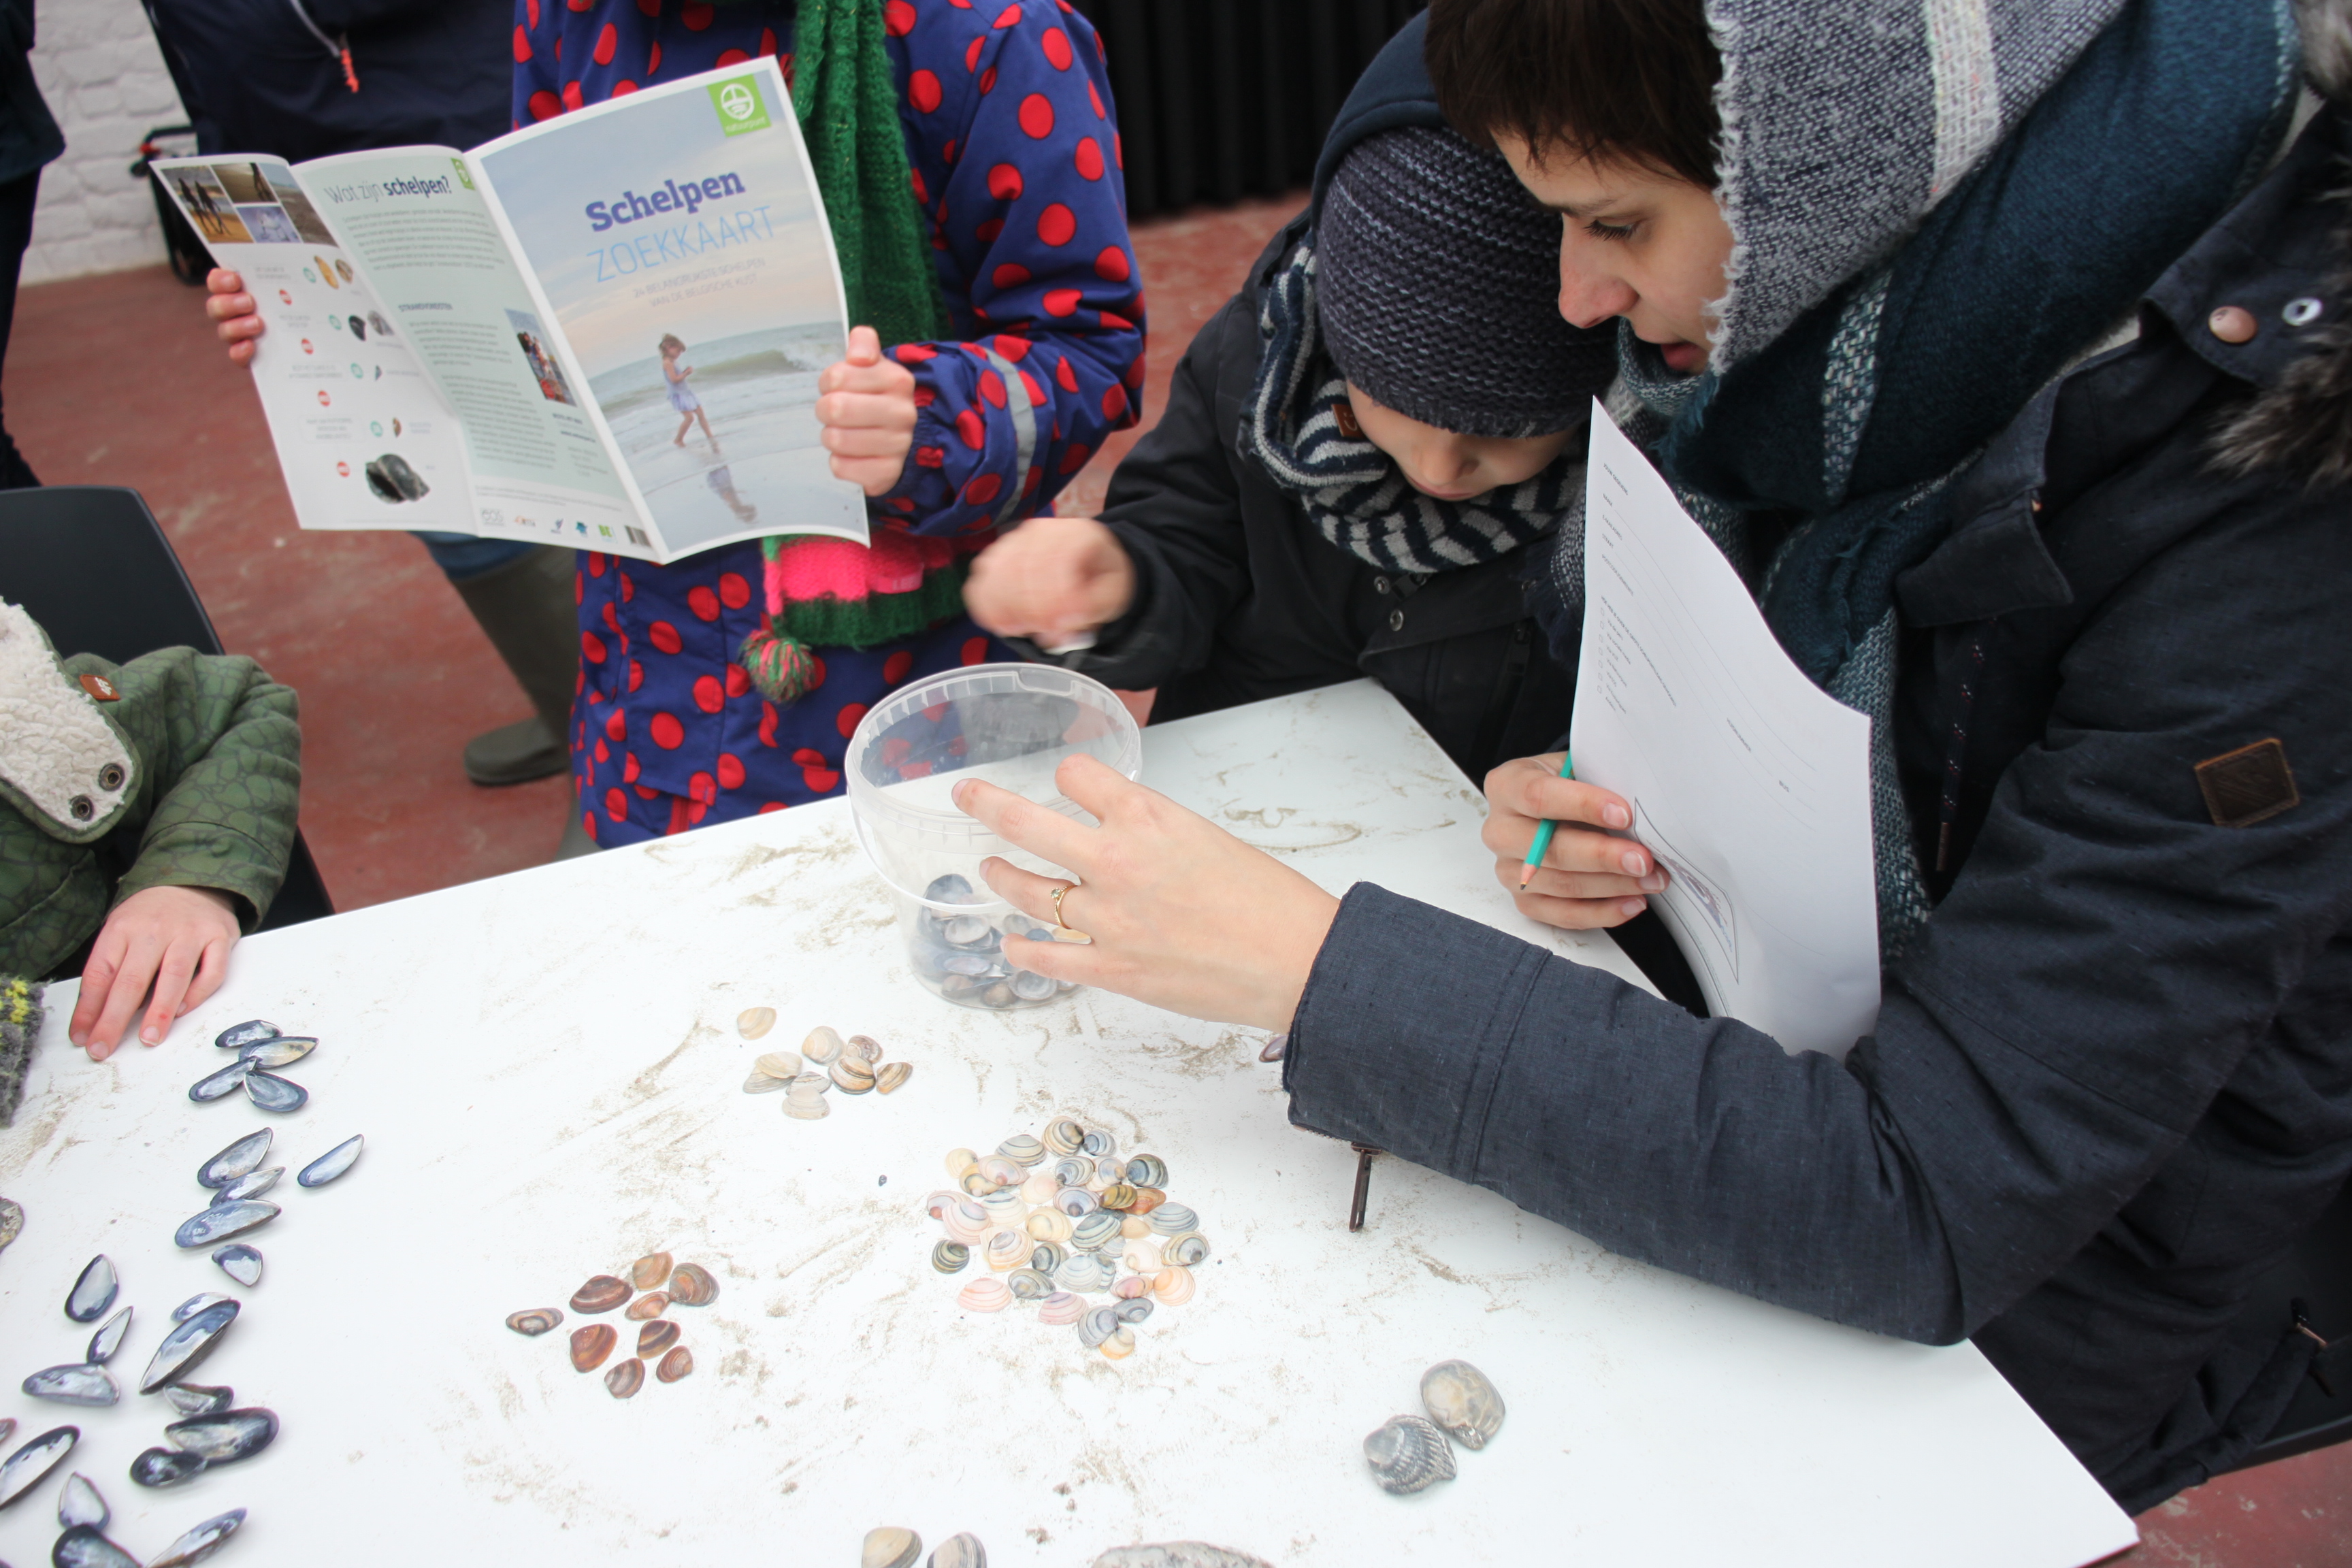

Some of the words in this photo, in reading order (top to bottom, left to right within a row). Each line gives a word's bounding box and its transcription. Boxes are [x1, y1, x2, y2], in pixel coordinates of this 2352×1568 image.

[323, 184, 359, 204] Wat
[359, 181, 384, 202] zijn
[382, 175, 453, 198] schelpen?
[585, 172, 746, 232] Schelpen
[586, 206, 774, 283] ZOEKKAART
